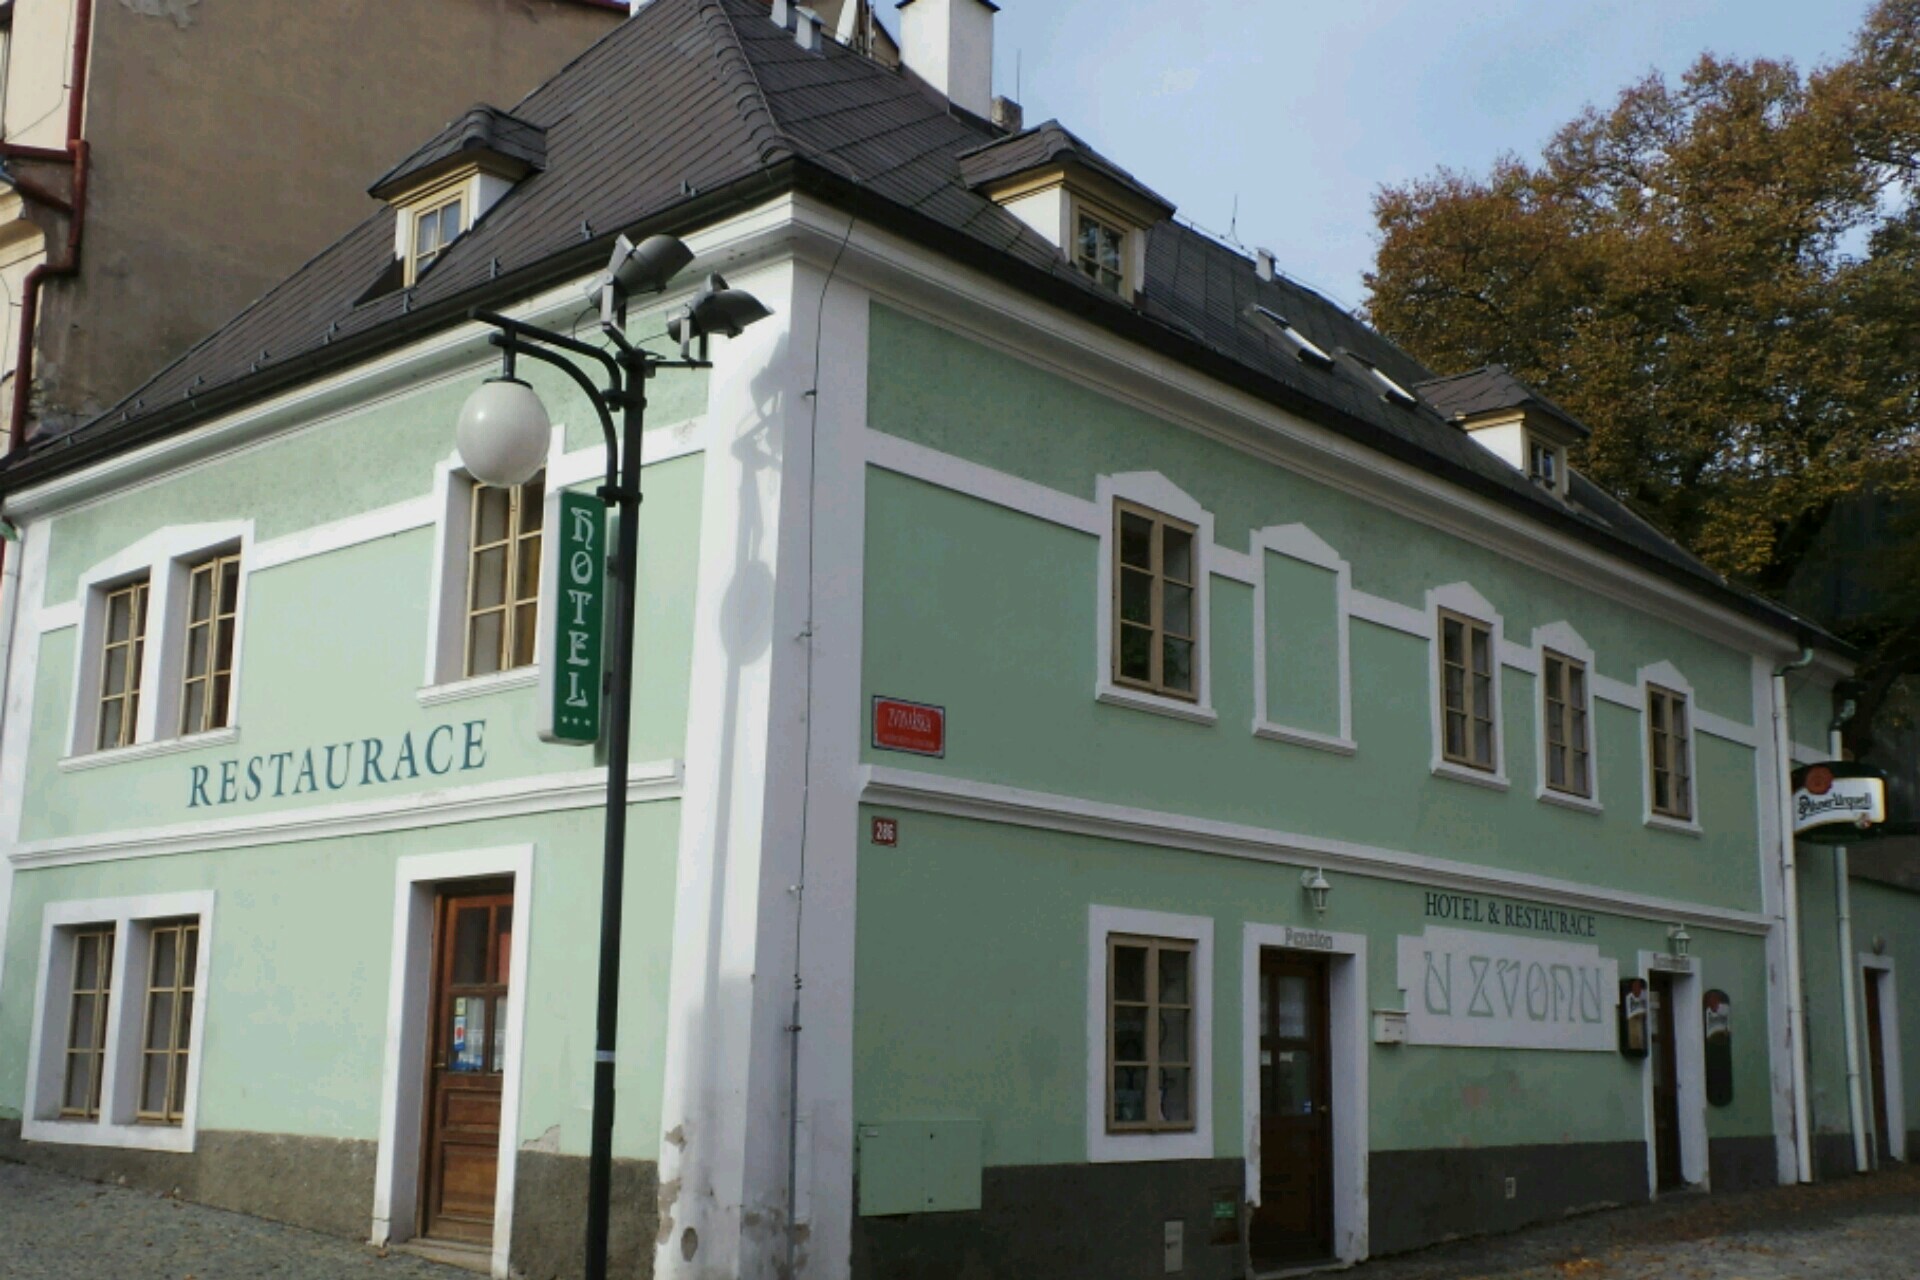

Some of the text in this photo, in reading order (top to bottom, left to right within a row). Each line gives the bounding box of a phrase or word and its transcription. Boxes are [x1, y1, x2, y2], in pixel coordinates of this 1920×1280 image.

[565, 507, 595, 708] HOTEL
[187, 719, 487, 808] RESTAURACE
[1424, 892, 1596, 937] HOTEL & RESTAURACE
